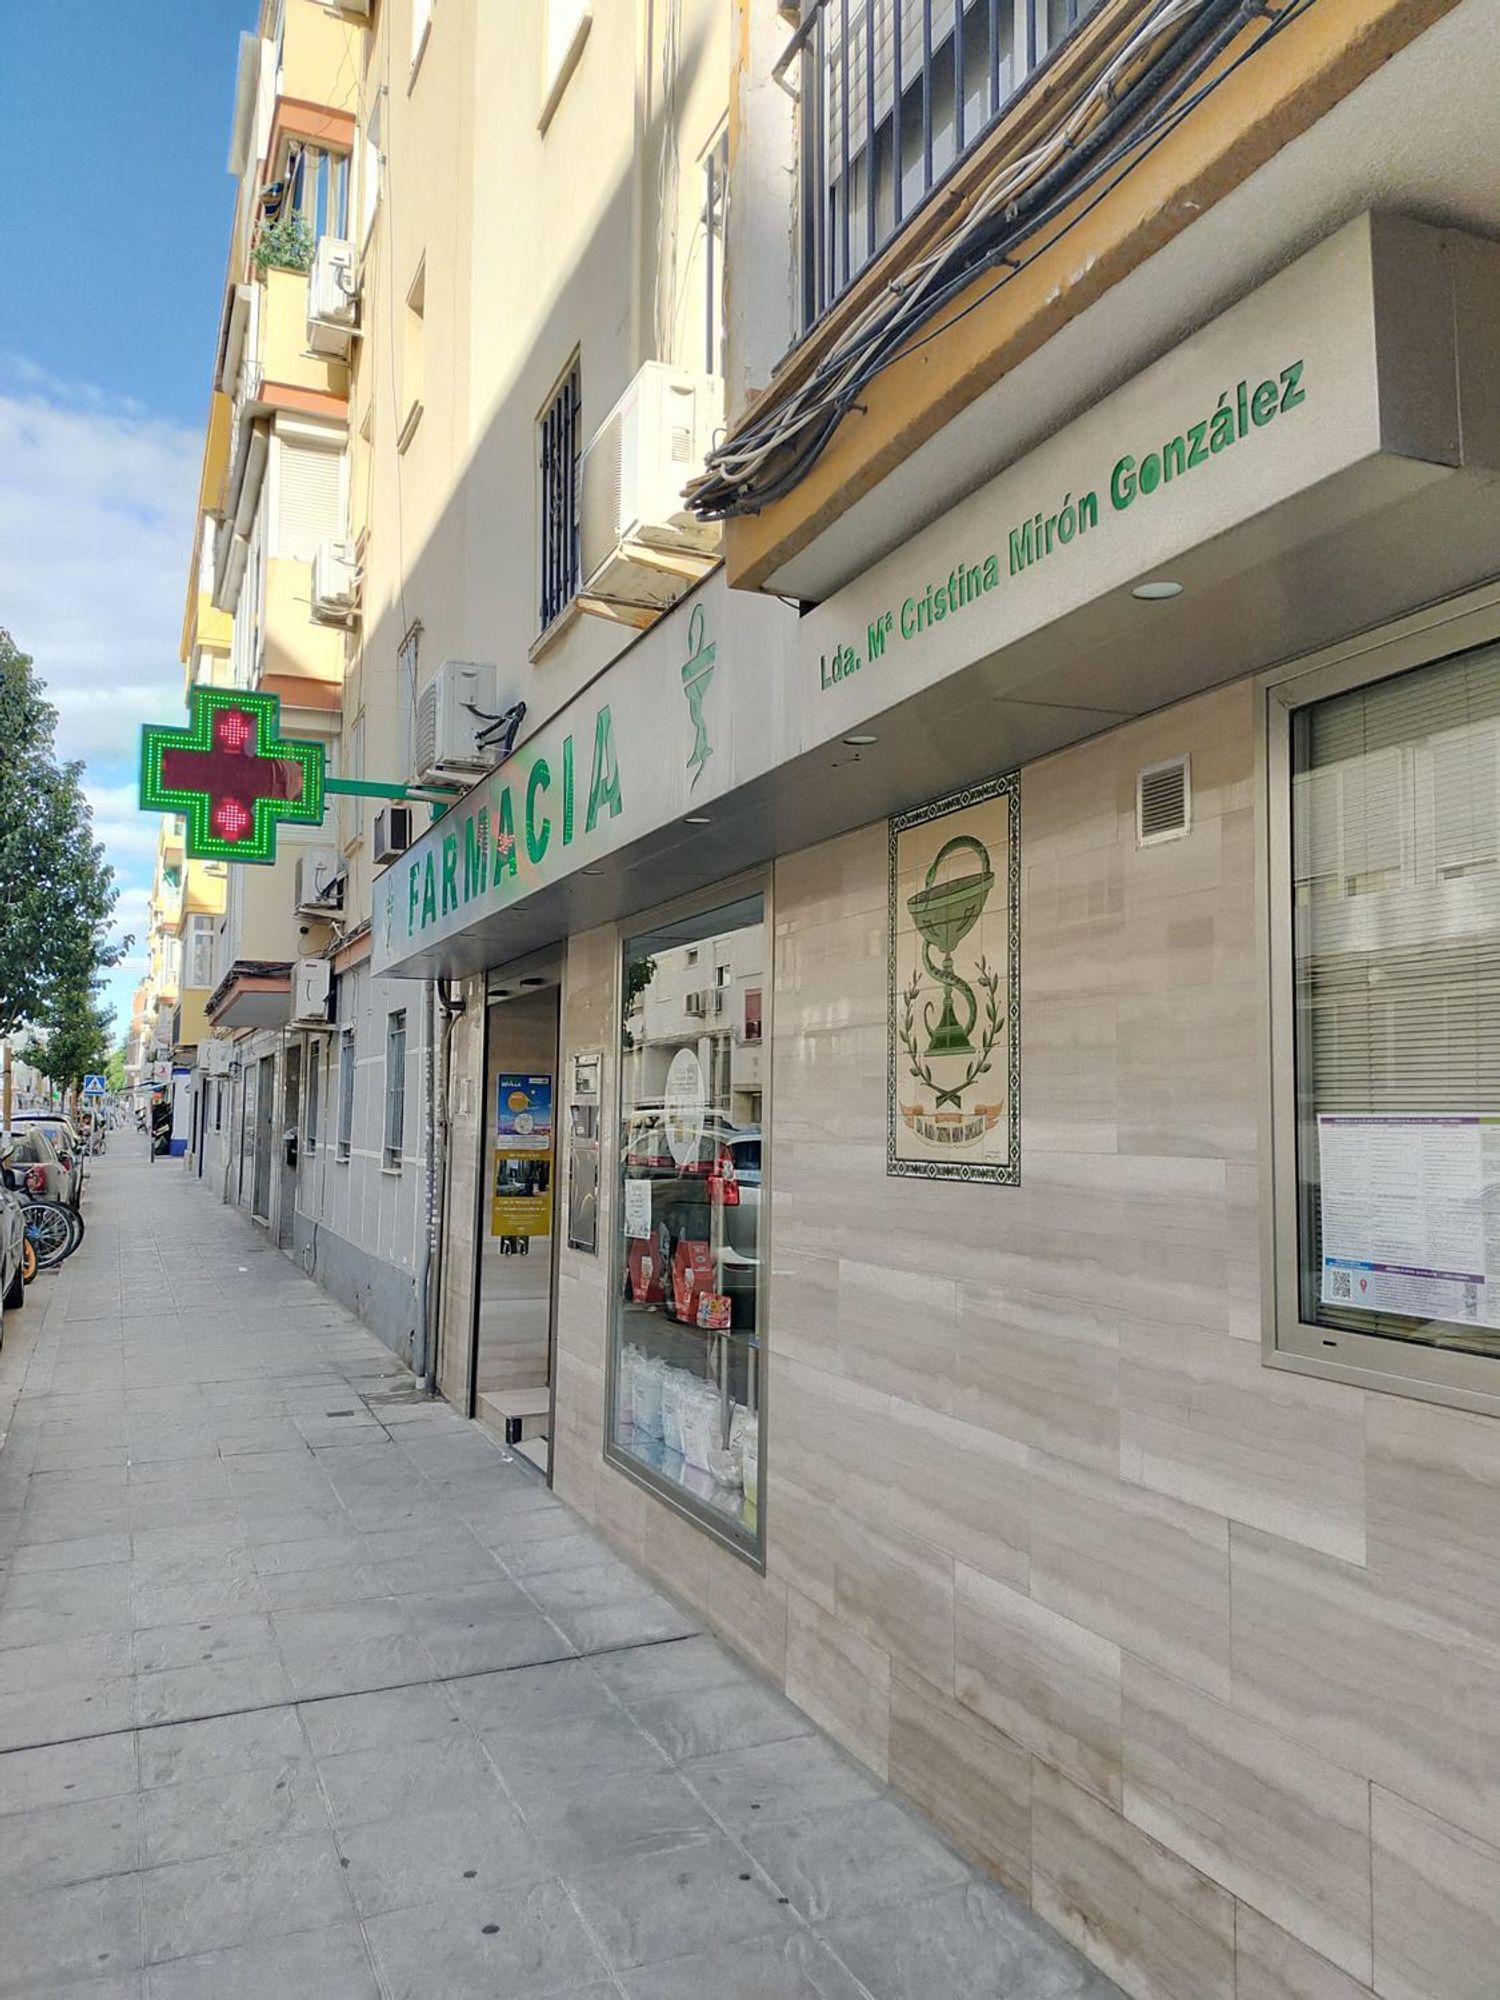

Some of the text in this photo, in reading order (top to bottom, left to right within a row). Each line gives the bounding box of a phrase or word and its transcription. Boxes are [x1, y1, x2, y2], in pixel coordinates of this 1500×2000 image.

[820, 359, 1306, 691] Lda. Mª Cristina Mirón González
[408, 703, 623, 937] FARMACIA
